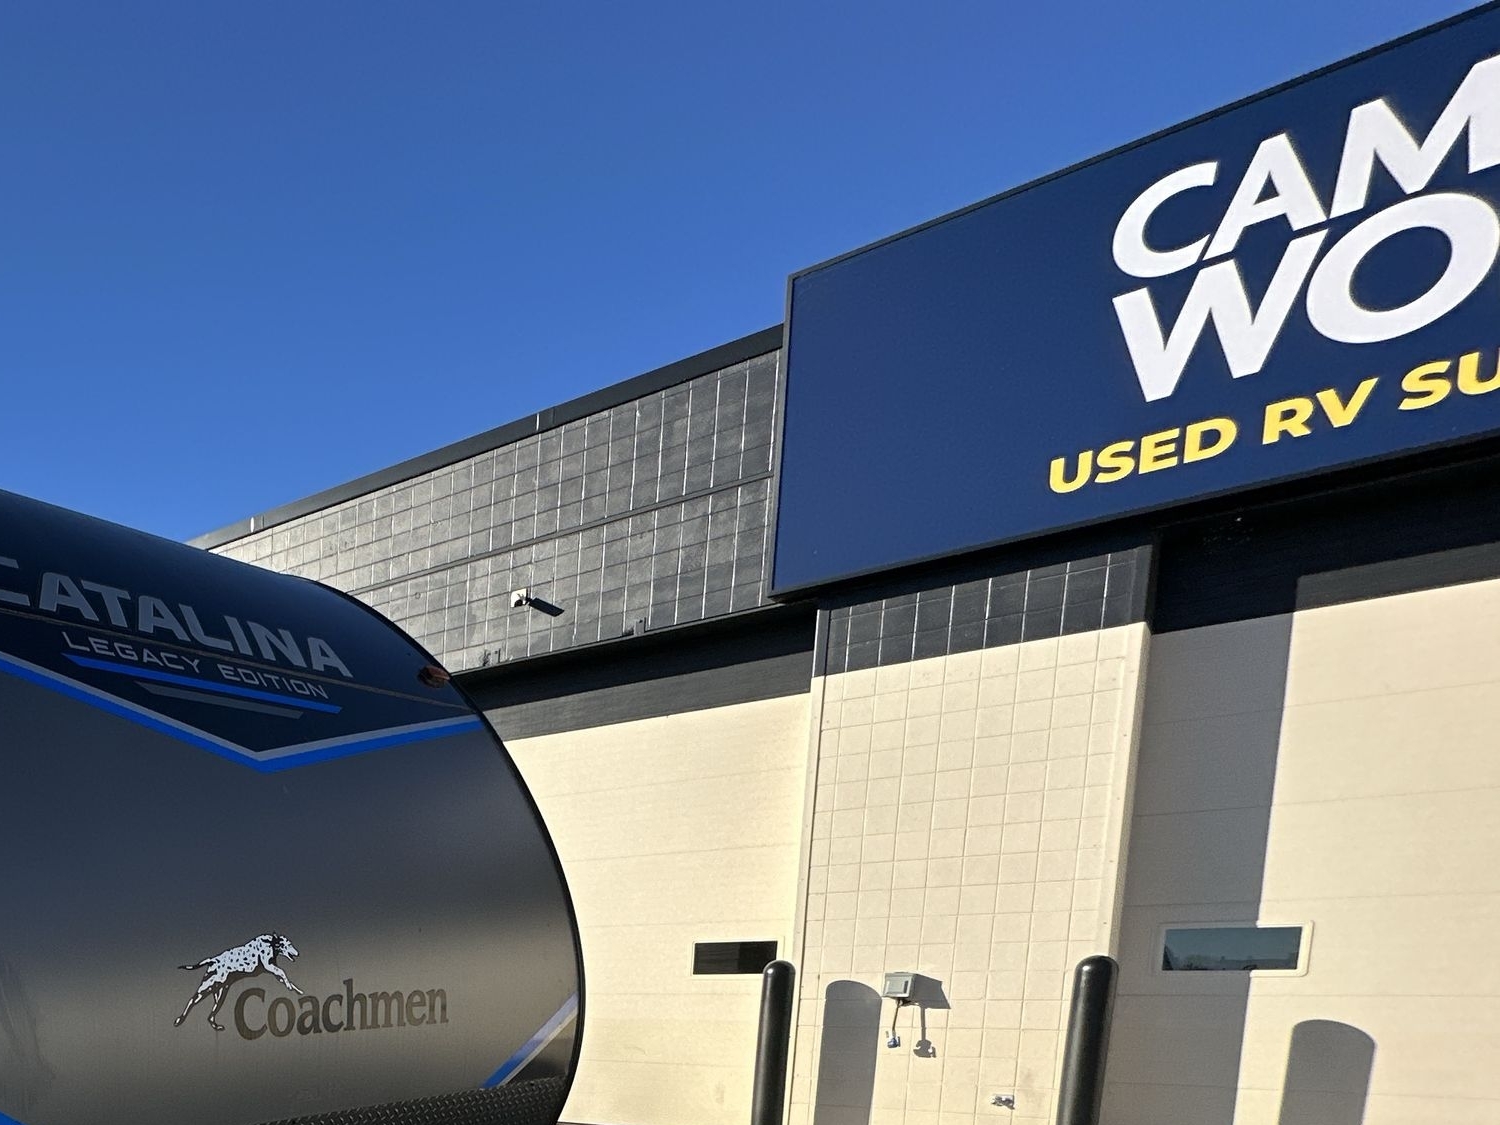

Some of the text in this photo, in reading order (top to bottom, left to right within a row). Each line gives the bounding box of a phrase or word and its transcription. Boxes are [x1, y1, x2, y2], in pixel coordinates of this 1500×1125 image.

[1112, 192, 1500, 403] WO
[1048, 347, 1500, 494] USED RV SU
[61, 631, 329, 699] LEGACY EDITION
[233, 978, 449, 1041] Coachmen
